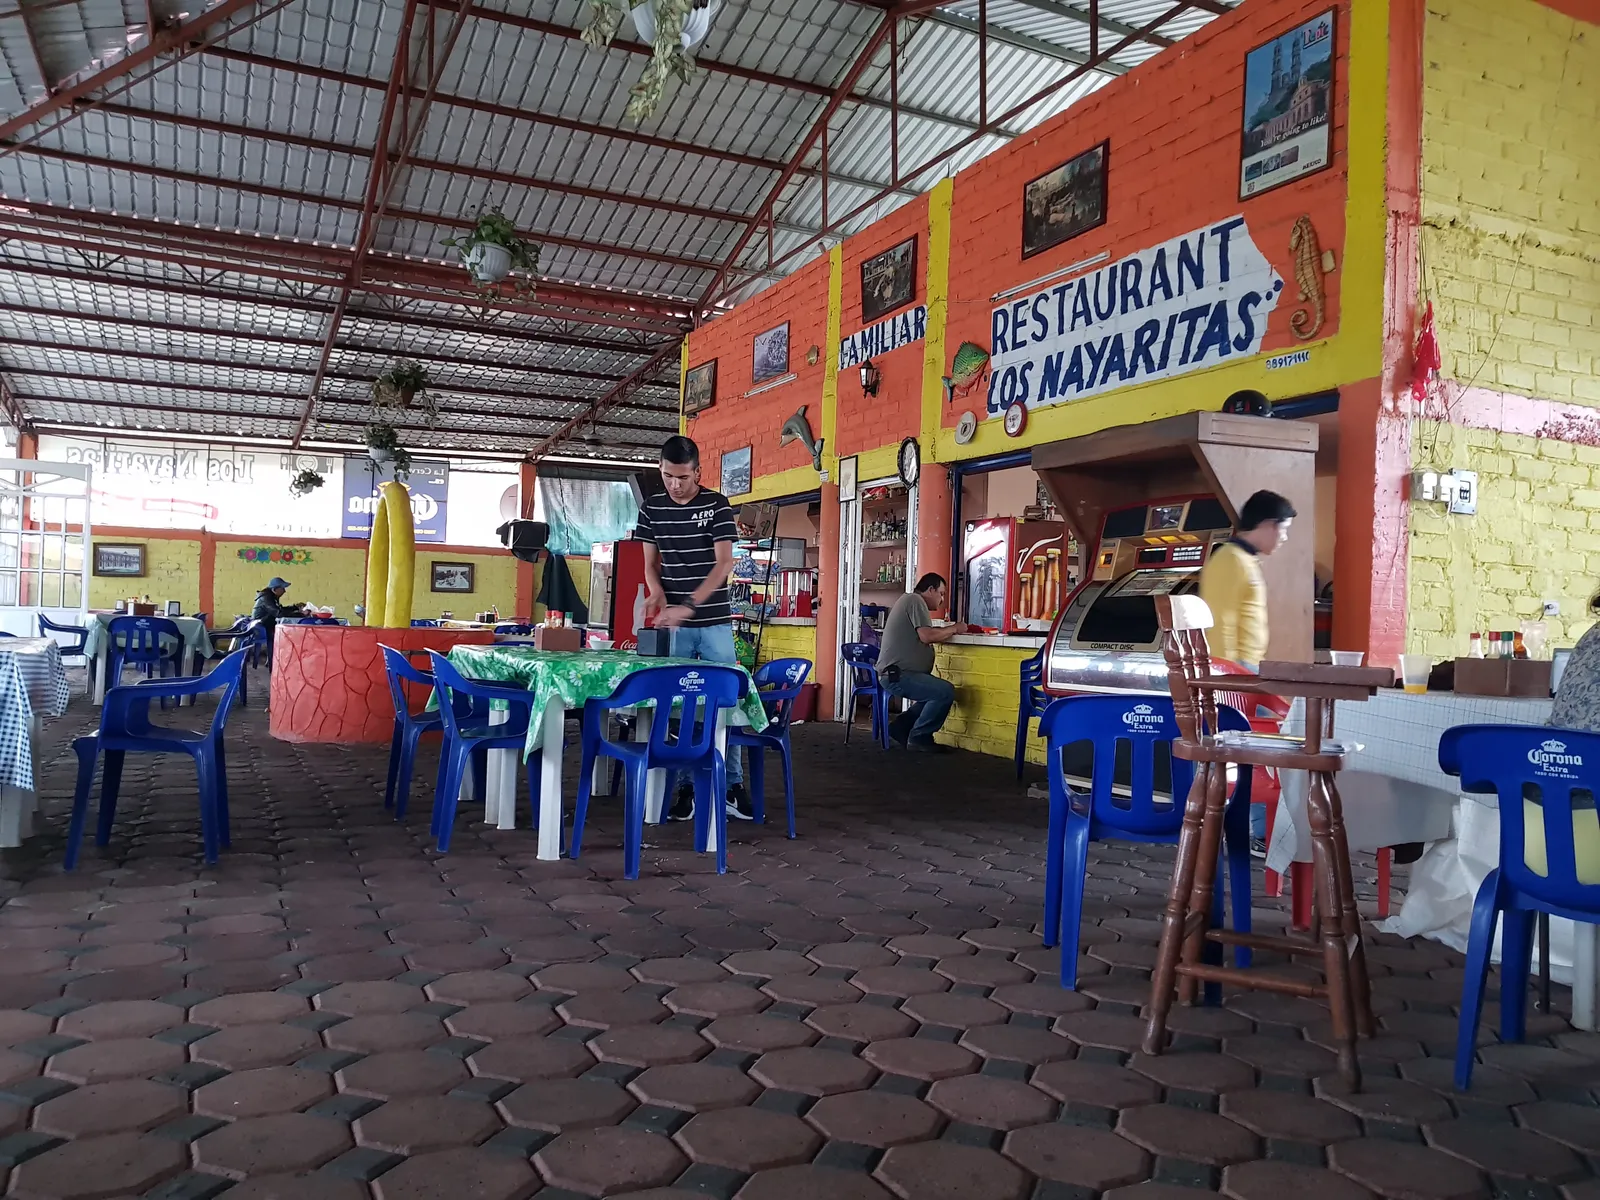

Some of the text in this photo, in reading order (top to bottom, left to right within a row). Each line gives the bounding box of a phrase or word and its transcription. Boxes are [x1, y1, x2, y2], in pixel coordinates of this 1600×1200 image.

[1282, 125, 1300, 141] going
[1302, 122, 1309, 130] to
[992, 217, 1244, 356] RESTAURANT
[840, 306, 925, 370] FAMILIAR
[987, 361, 1034, 413] LOS
[691, 509, 715, 520] AERO
[697, 520, 708, 528] NY
[620, 640, 637, 650] Coca
[679, 676, 705, 686] Corona
[1122, 711, 1164, 725] Corona
[1527, 748, 1583, 766] Corona
[1543, 763, 1569, 774] Extra
